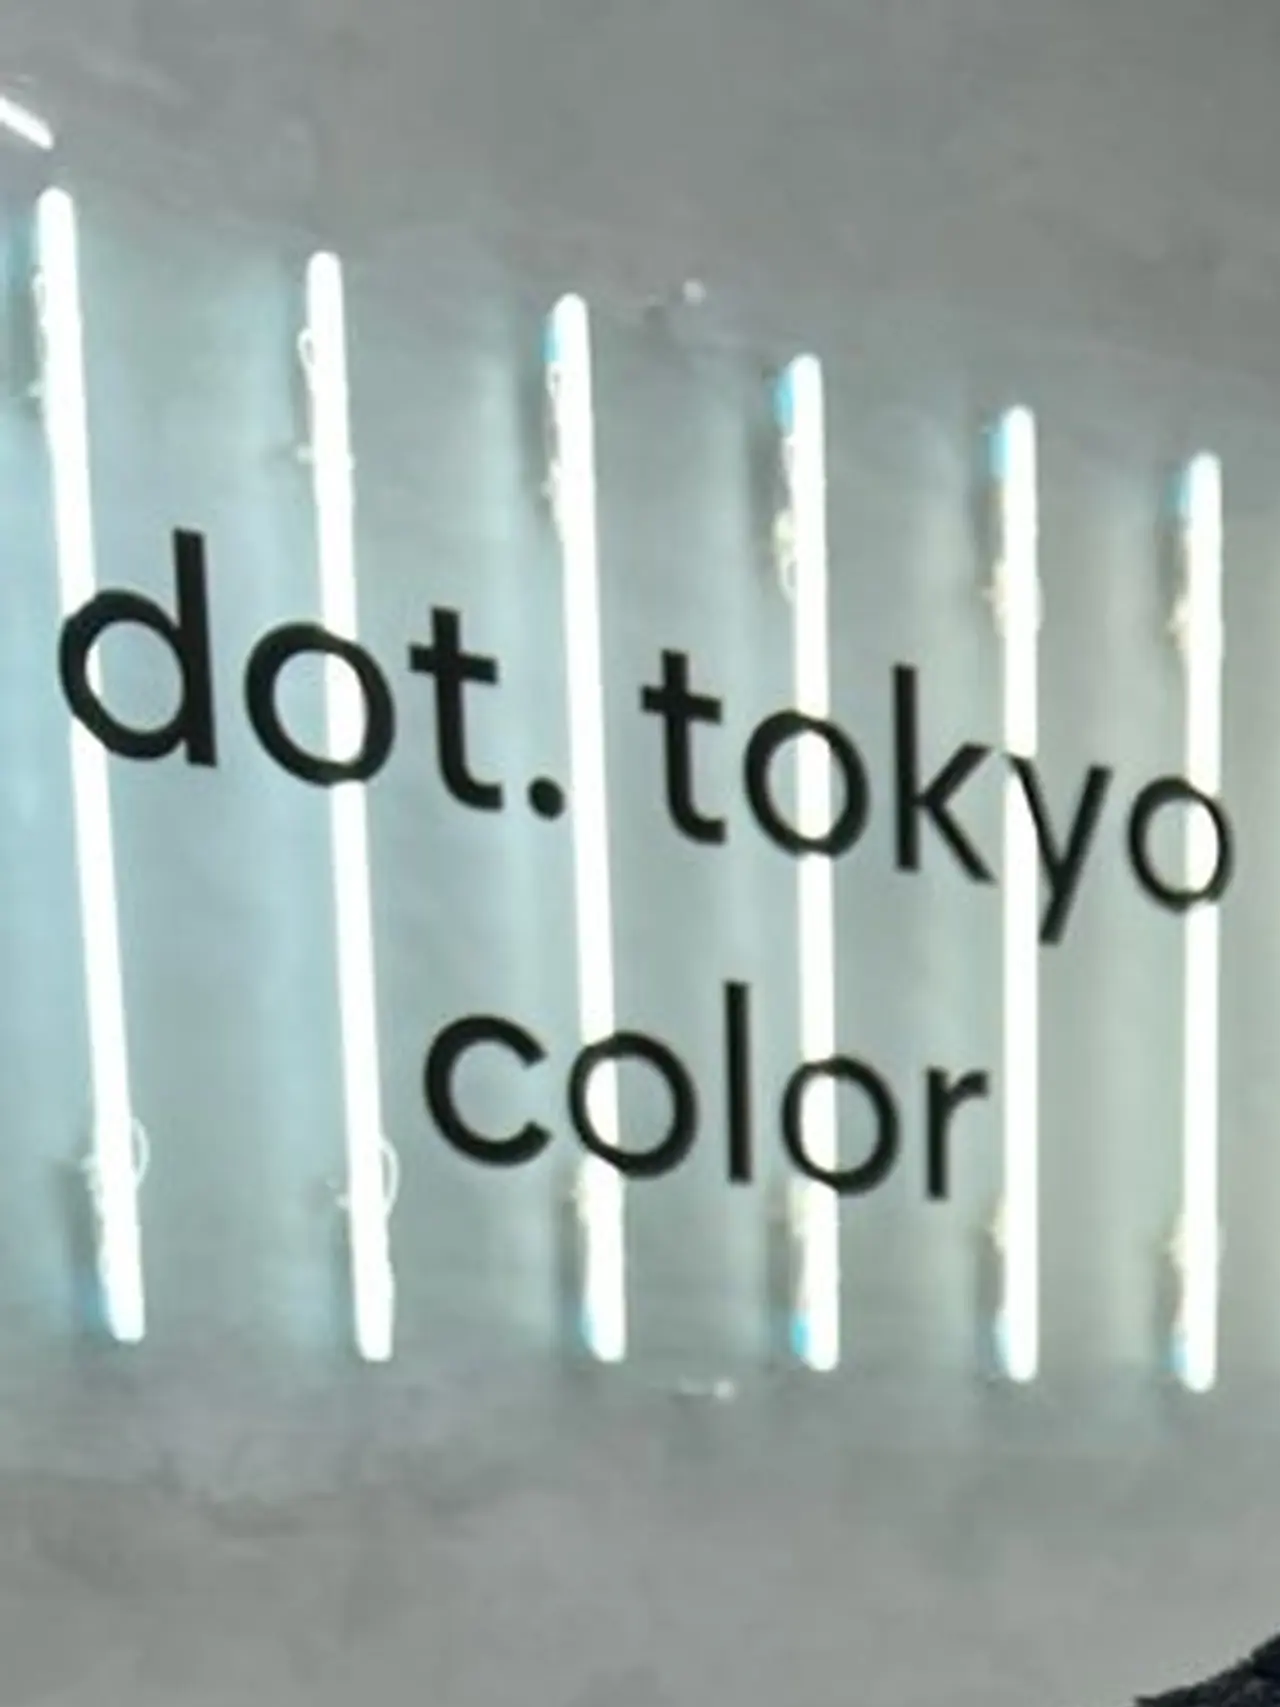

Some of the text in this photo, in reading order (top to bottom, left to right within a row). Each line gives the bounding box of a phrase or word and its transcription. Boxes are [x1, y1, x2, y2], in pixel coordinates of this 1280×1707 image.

[57, 528, 1234, 946] dot. tokyo
[423, 980, 988, 1202] color
